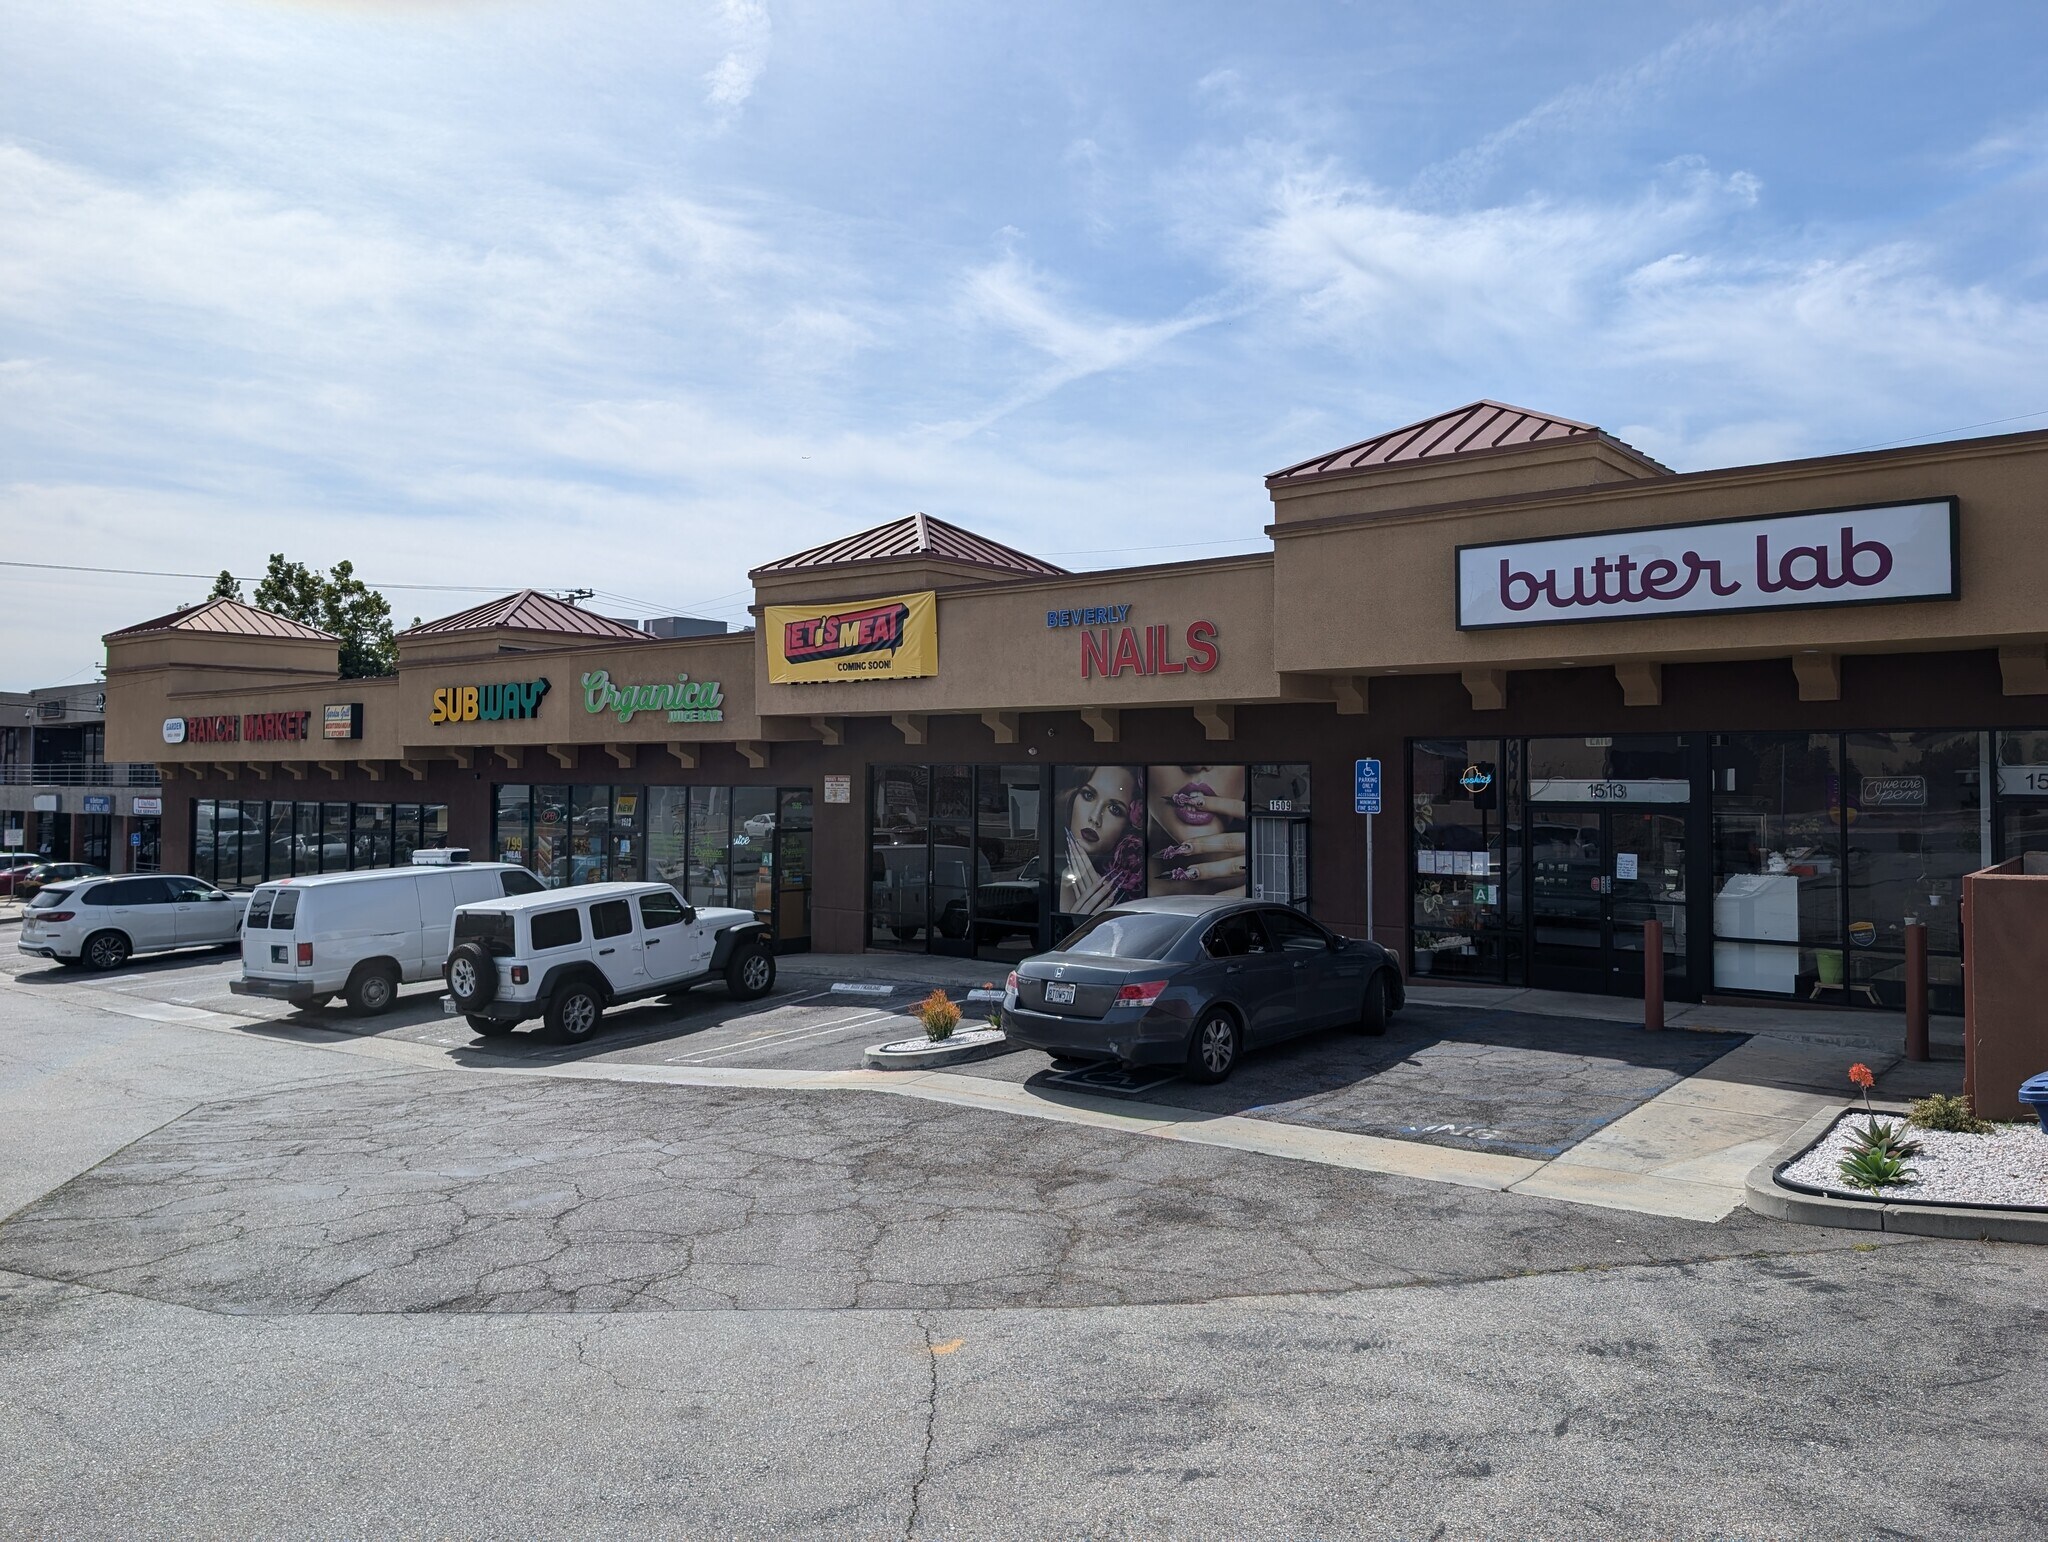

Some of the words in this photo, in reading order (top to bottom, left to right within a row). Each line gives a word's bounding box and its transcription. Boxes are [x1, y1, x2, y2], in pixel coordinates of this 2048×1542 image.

[1500, 550, 1742, 612] butter
[1756, 526, 1894, 594] lab
[1046, 604, 1131, 628] BEVERLY
[839, 603, 906, 649] MEAT
[1080, 620, 1219, 679] NAILS
[837, 661, 867, 672] COMING
[868, 659, 892, 670] SOON!
[428, 677, 552, 726] SUBWAY
[581, 669, 725, 723] Organica
[668, 710, 698, 723] JUICE
[698, 709, 723, 722] BAR
[166, 722, 182, 731] GARDEN
[188, 715, 239, 743] RANCH
[243, 711, 308, 742] MARKET
[1460, 772, 1492, 785] cookies
[1882, 780, 1901, 790] we
[1901, 779, 1922, 790] are
[1587, 784, 1626, 799] 1513
[1865, 781, 1924, 805] Open
[618, 804, 634, 812] NEW
[1270, 800, 1292, 812] 1509
[506, 851, 523, 859] MEAL
[763, 855, 769, 864] A
[1475, 888, 1487, 900] A
